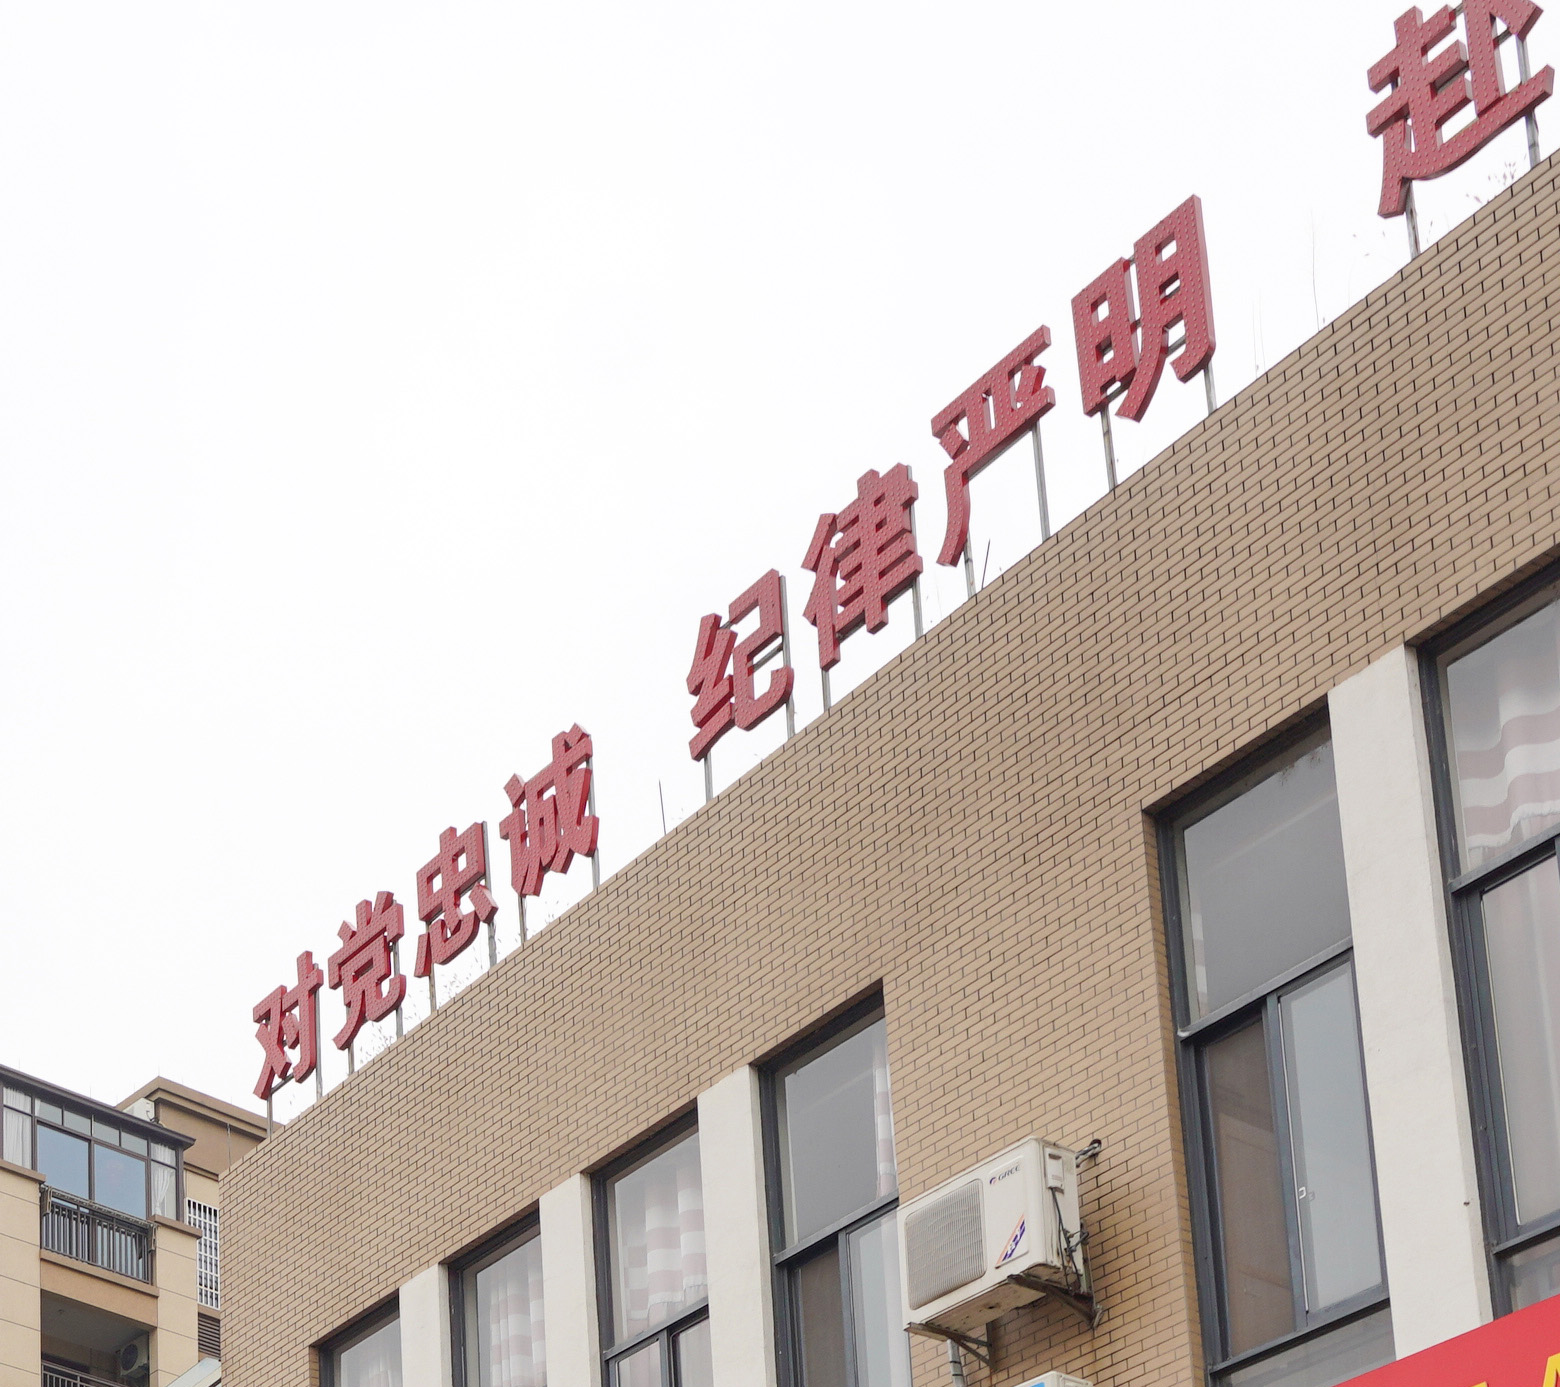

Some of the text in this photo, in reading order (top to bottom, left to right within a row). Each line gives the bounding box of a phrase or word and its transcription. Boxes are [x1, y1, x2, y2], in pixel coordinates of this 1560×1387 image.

[686, 194, 1216, 761] 纪律严明
[253, 722, 600, 1100] 对党忠诚
